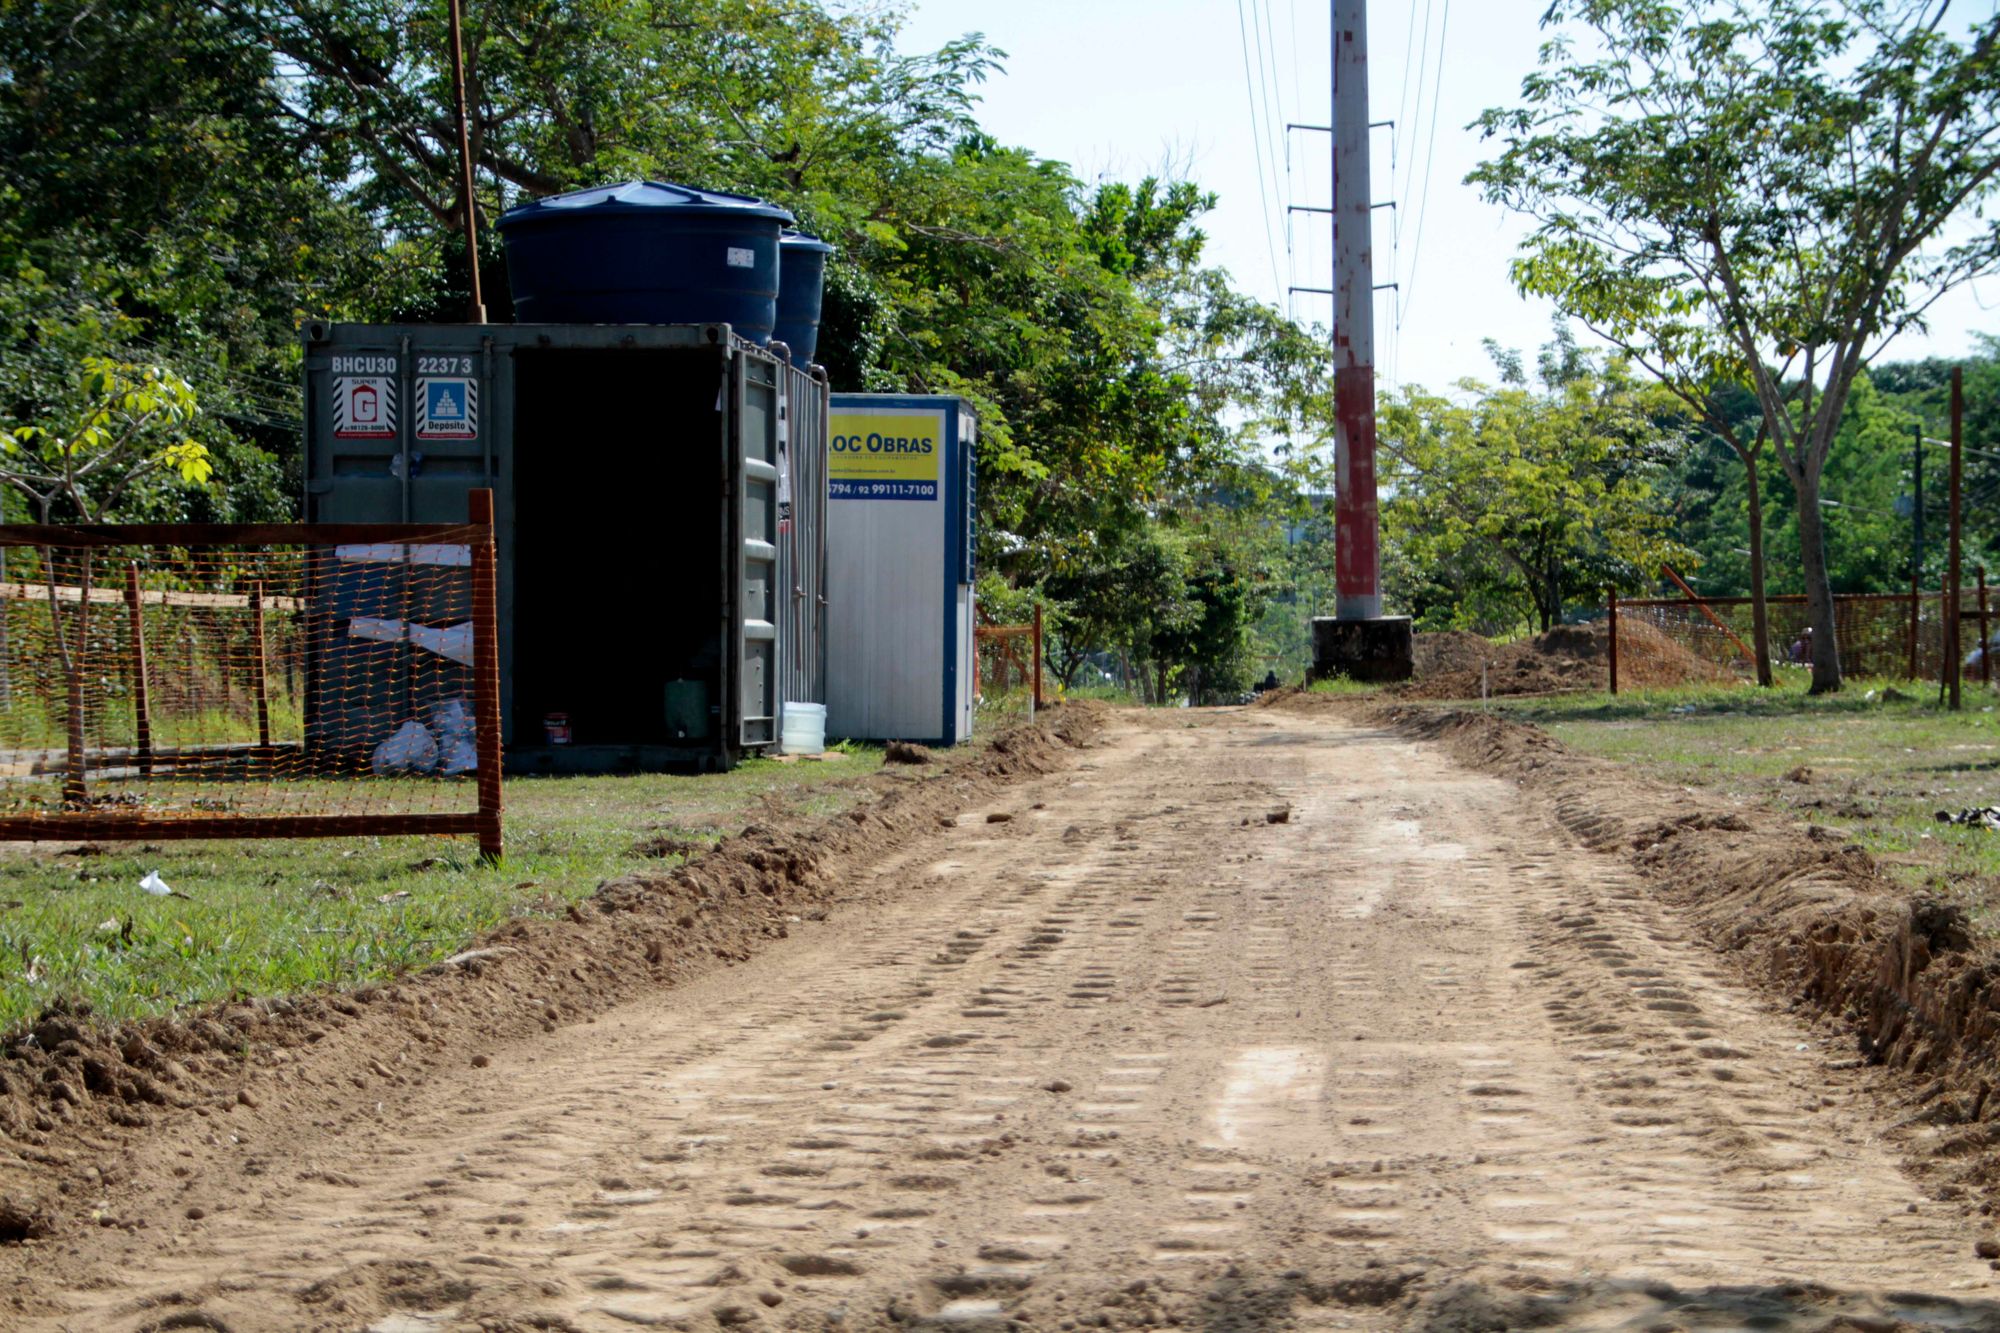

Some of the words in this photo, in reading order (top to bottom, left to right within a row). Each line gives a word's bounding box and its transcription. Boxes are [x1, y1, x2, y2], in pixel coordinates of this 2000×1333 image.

[331, 356, 397, 373] BHCU30
[428, 420, 466, 432] Depósito
[829, 435, 862, 452] OC
[858, 486, 869, 494] 92
[871, 484, 934, 495] 99111-7100
